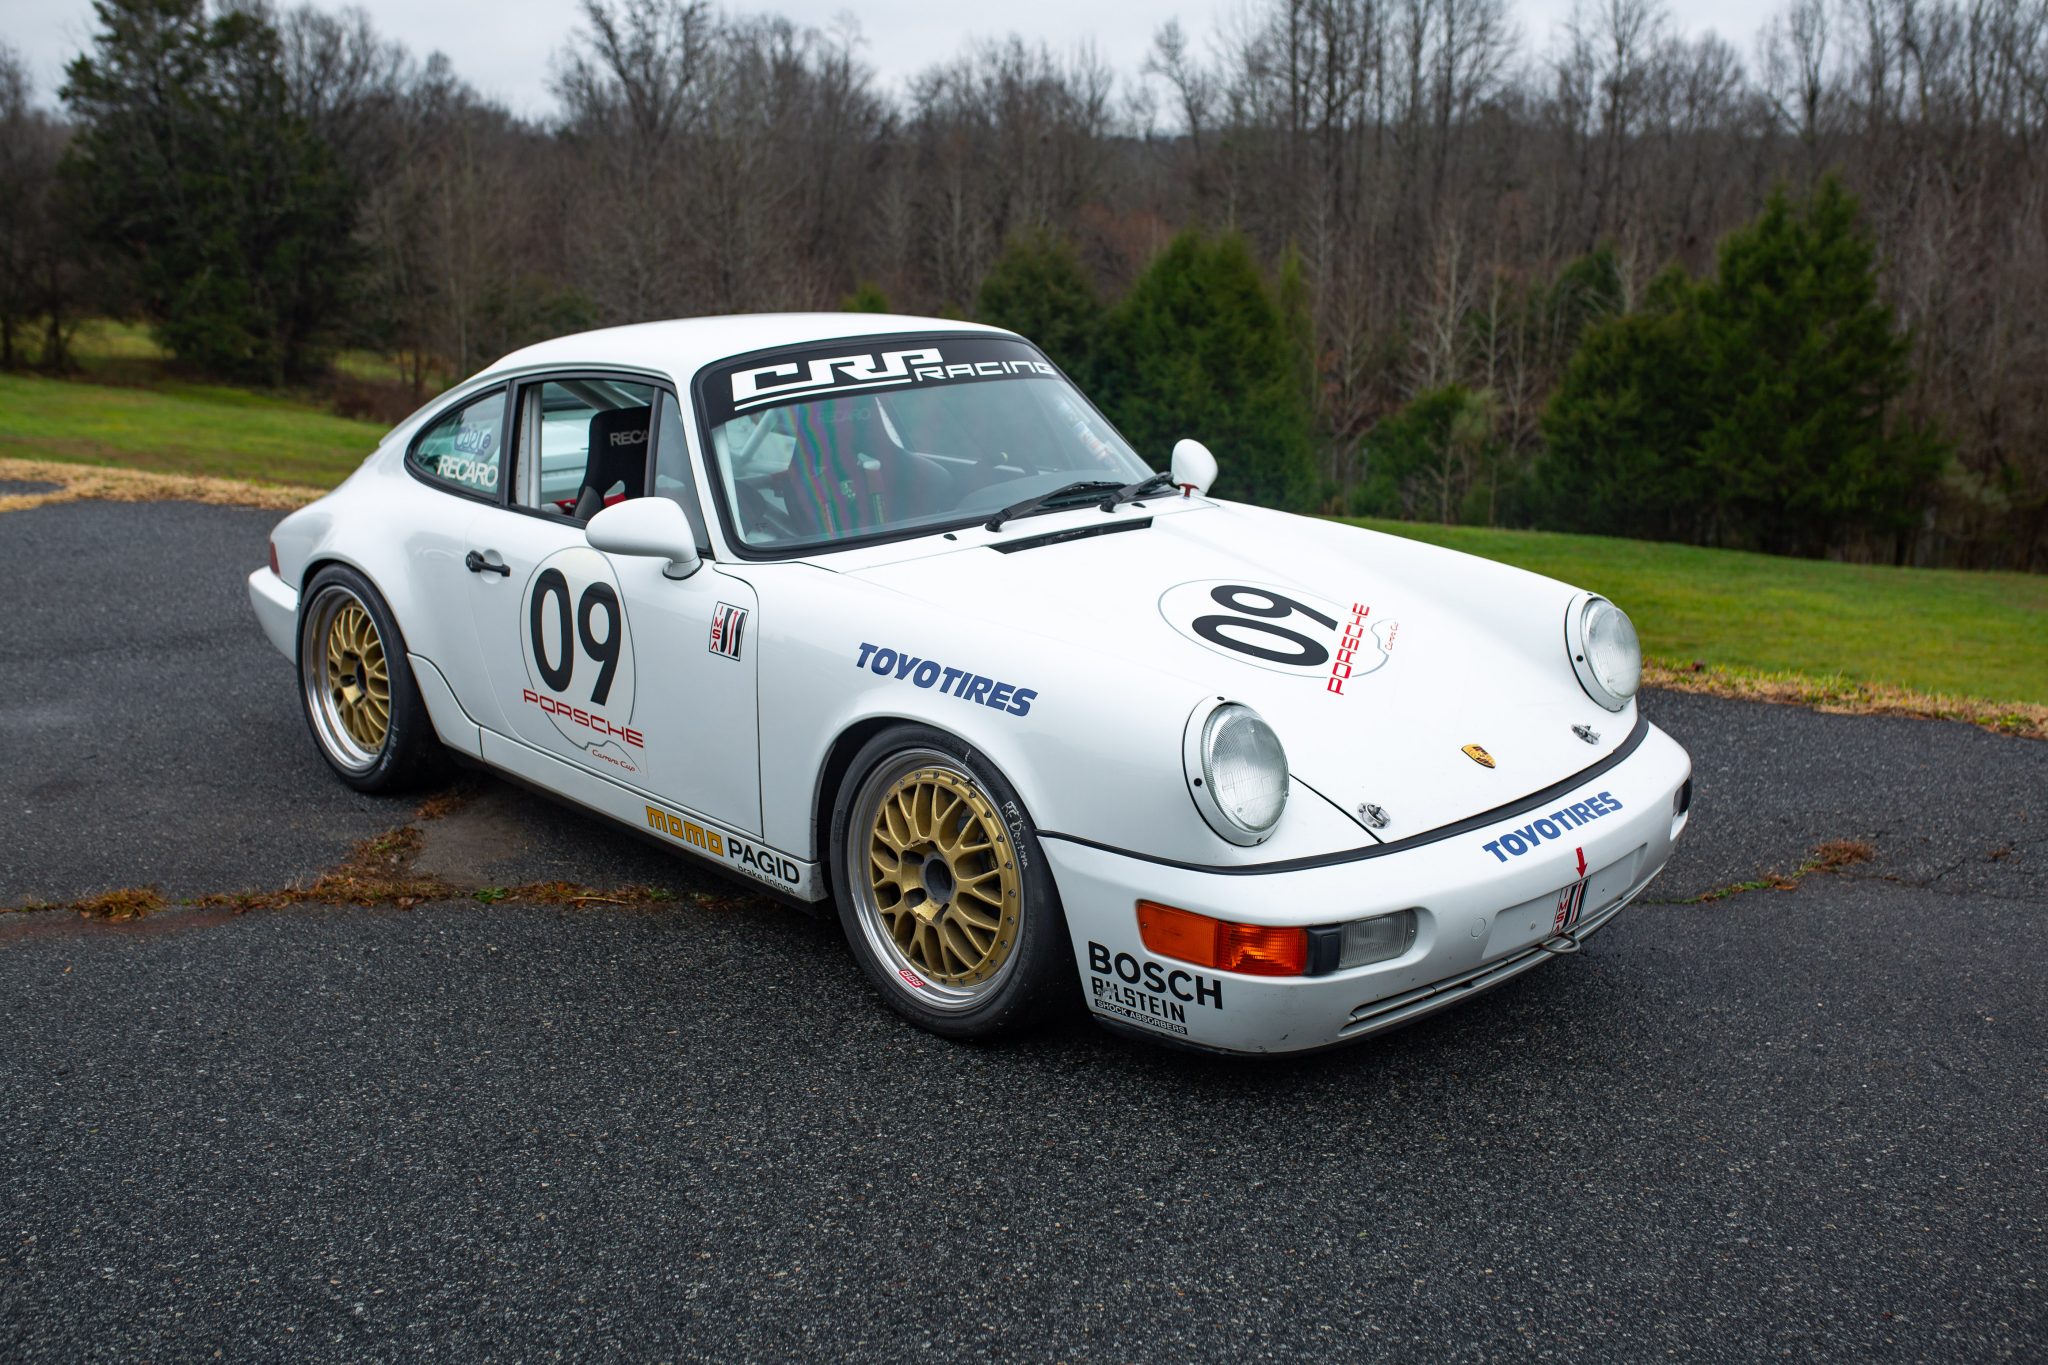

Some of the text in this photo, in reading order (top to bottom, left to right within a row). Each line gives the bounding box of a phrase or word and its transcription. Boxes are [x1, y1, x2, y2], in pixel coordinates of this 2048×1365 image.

[731, 348, 944, 402] CRP
[437, 455, 499, 488] RECARO
[530, 567, 622, 706] 09
[711, 606, 723, 652] IMSA
[1192, 584, 1339, 666] 09
[1327, 602, 1370, 695] PORSCHE
[523, 688, 644, 749] PORSCHE
[592, 749, 636, 772] Carrera Cup
[727, 837, 800, 885] PAGID
[899, 969, 926, 987] BBS
[1088, 941, 1224, 1010] BOSCH
[1097, 1000, 1186, 1035] SHOCK ABSORBERS
